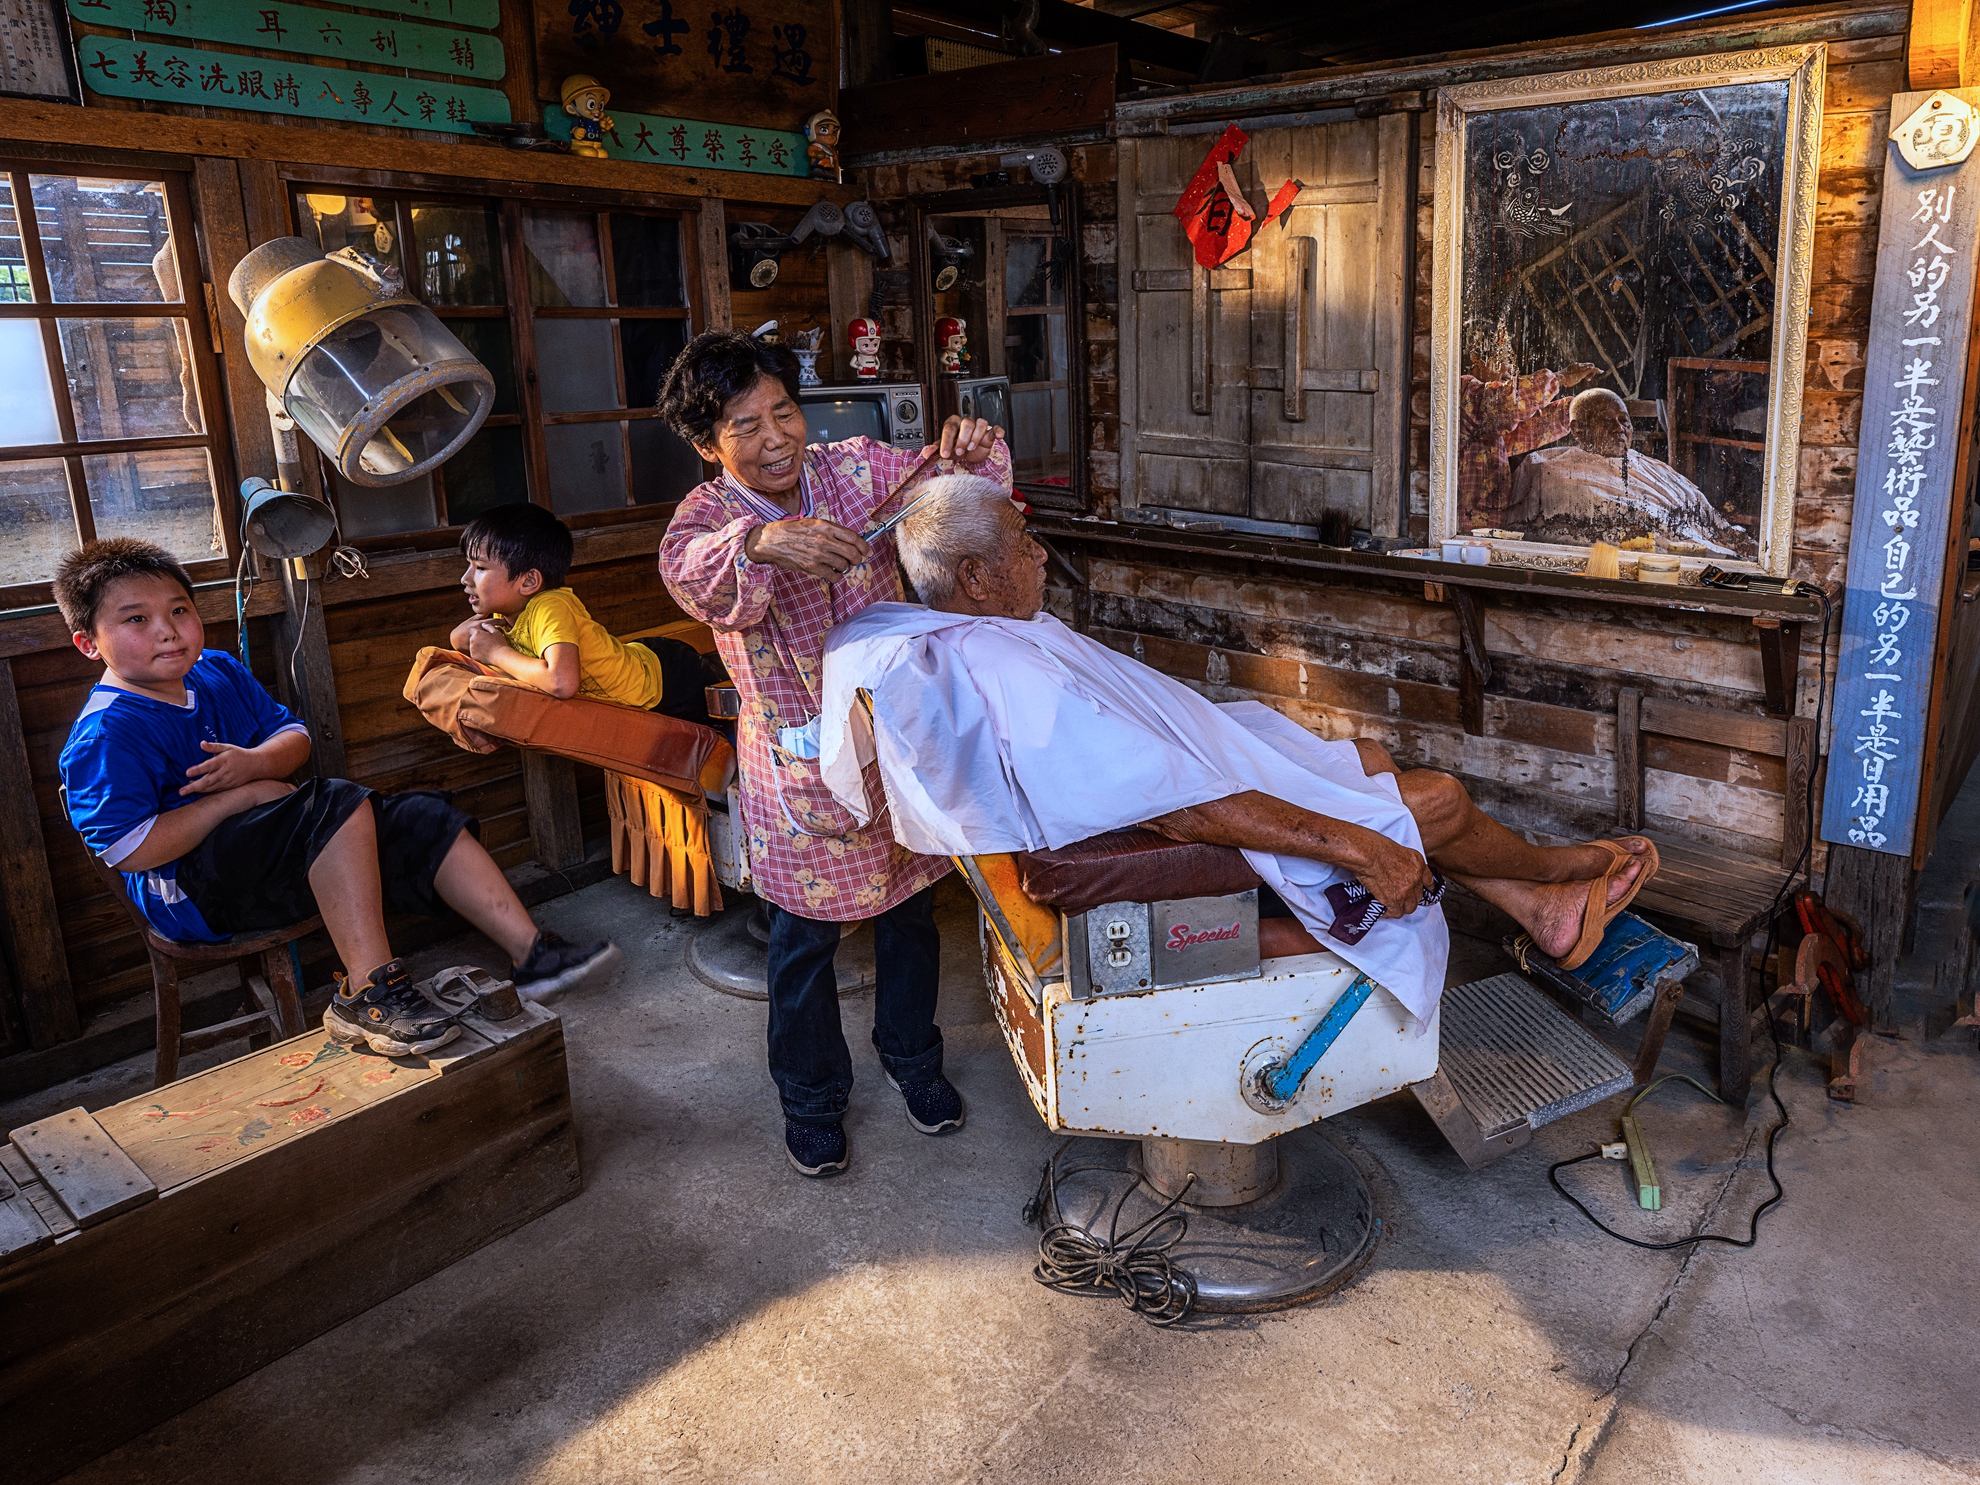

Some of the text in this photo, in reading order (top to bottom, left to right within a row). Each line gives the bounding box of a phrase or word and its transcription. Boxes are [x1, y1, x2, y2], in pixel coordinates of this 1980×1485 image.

[567, 0, 816, 86] 紳士禮遇
[1166, 922, 1241, 951] Special
